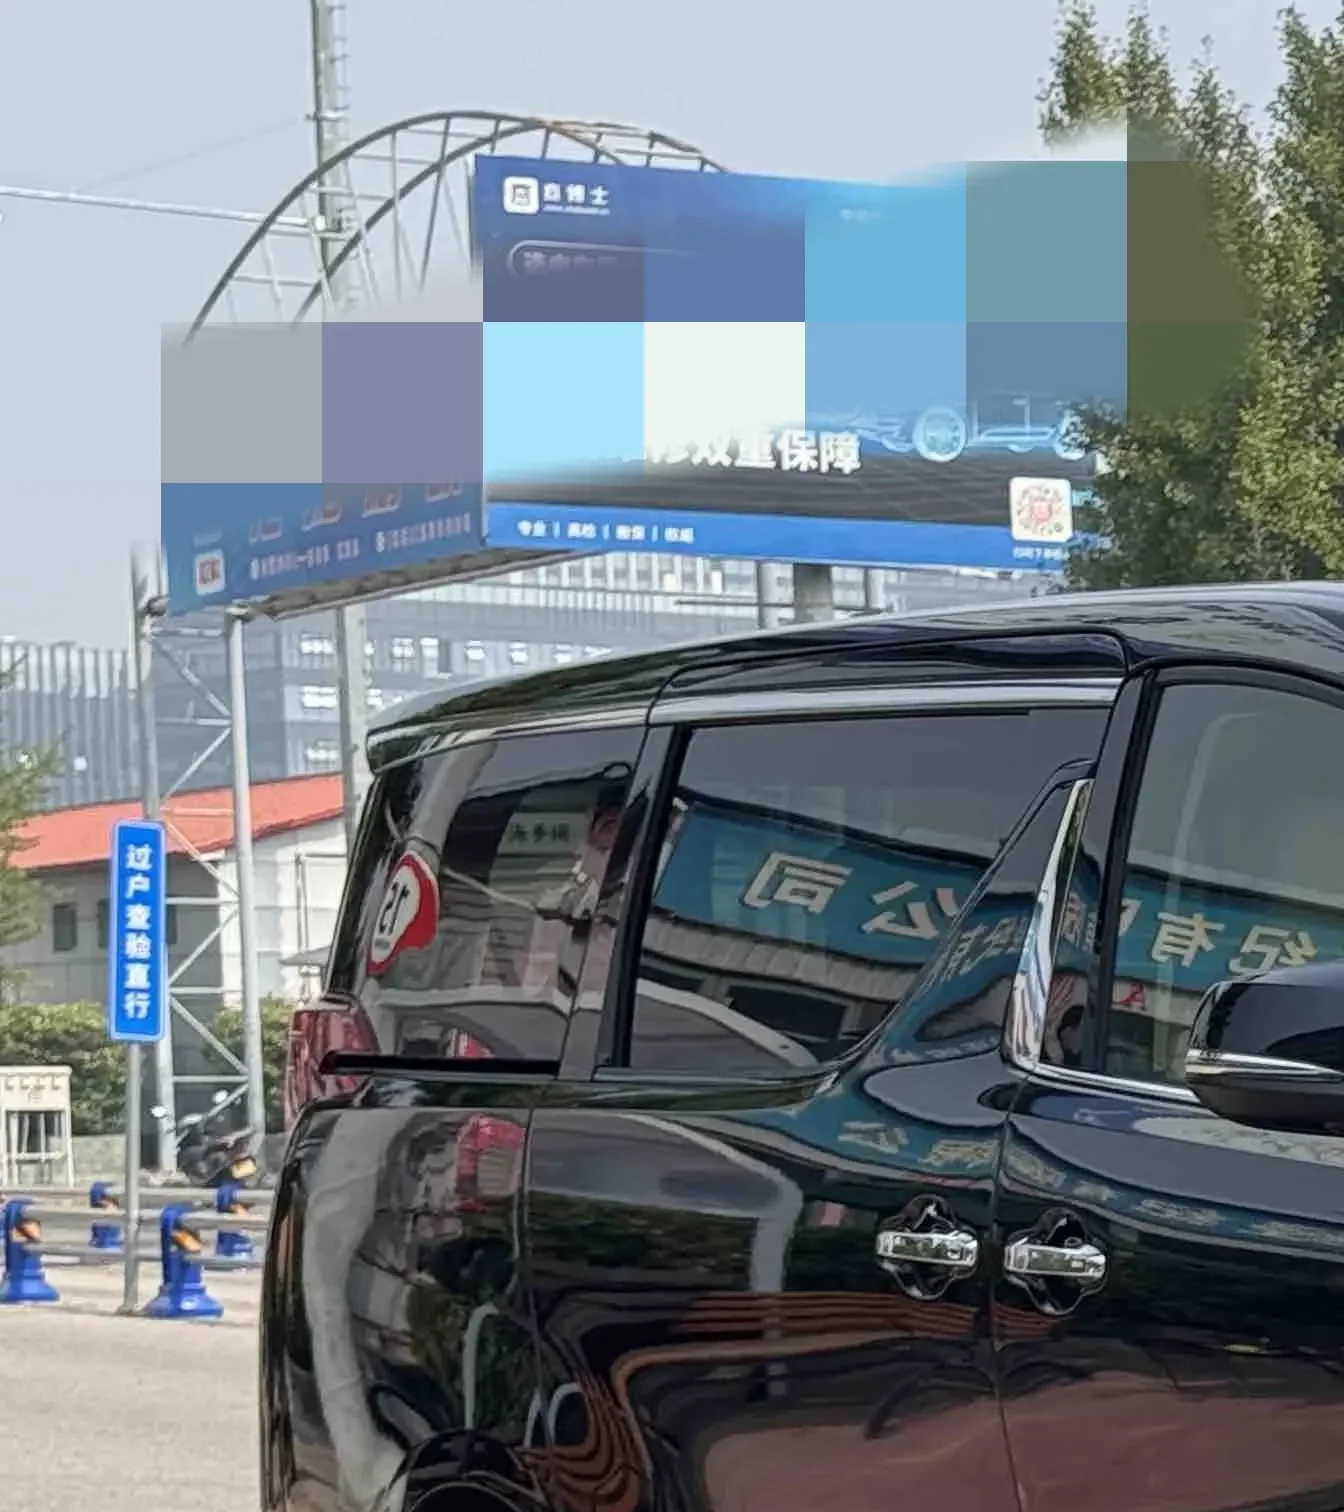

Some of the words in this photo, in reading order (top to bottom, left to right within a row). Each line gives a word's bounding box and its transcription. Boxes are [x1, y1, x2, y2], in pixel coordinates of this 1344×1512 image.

[124, 844, 153, 1019] 过户查验直行
